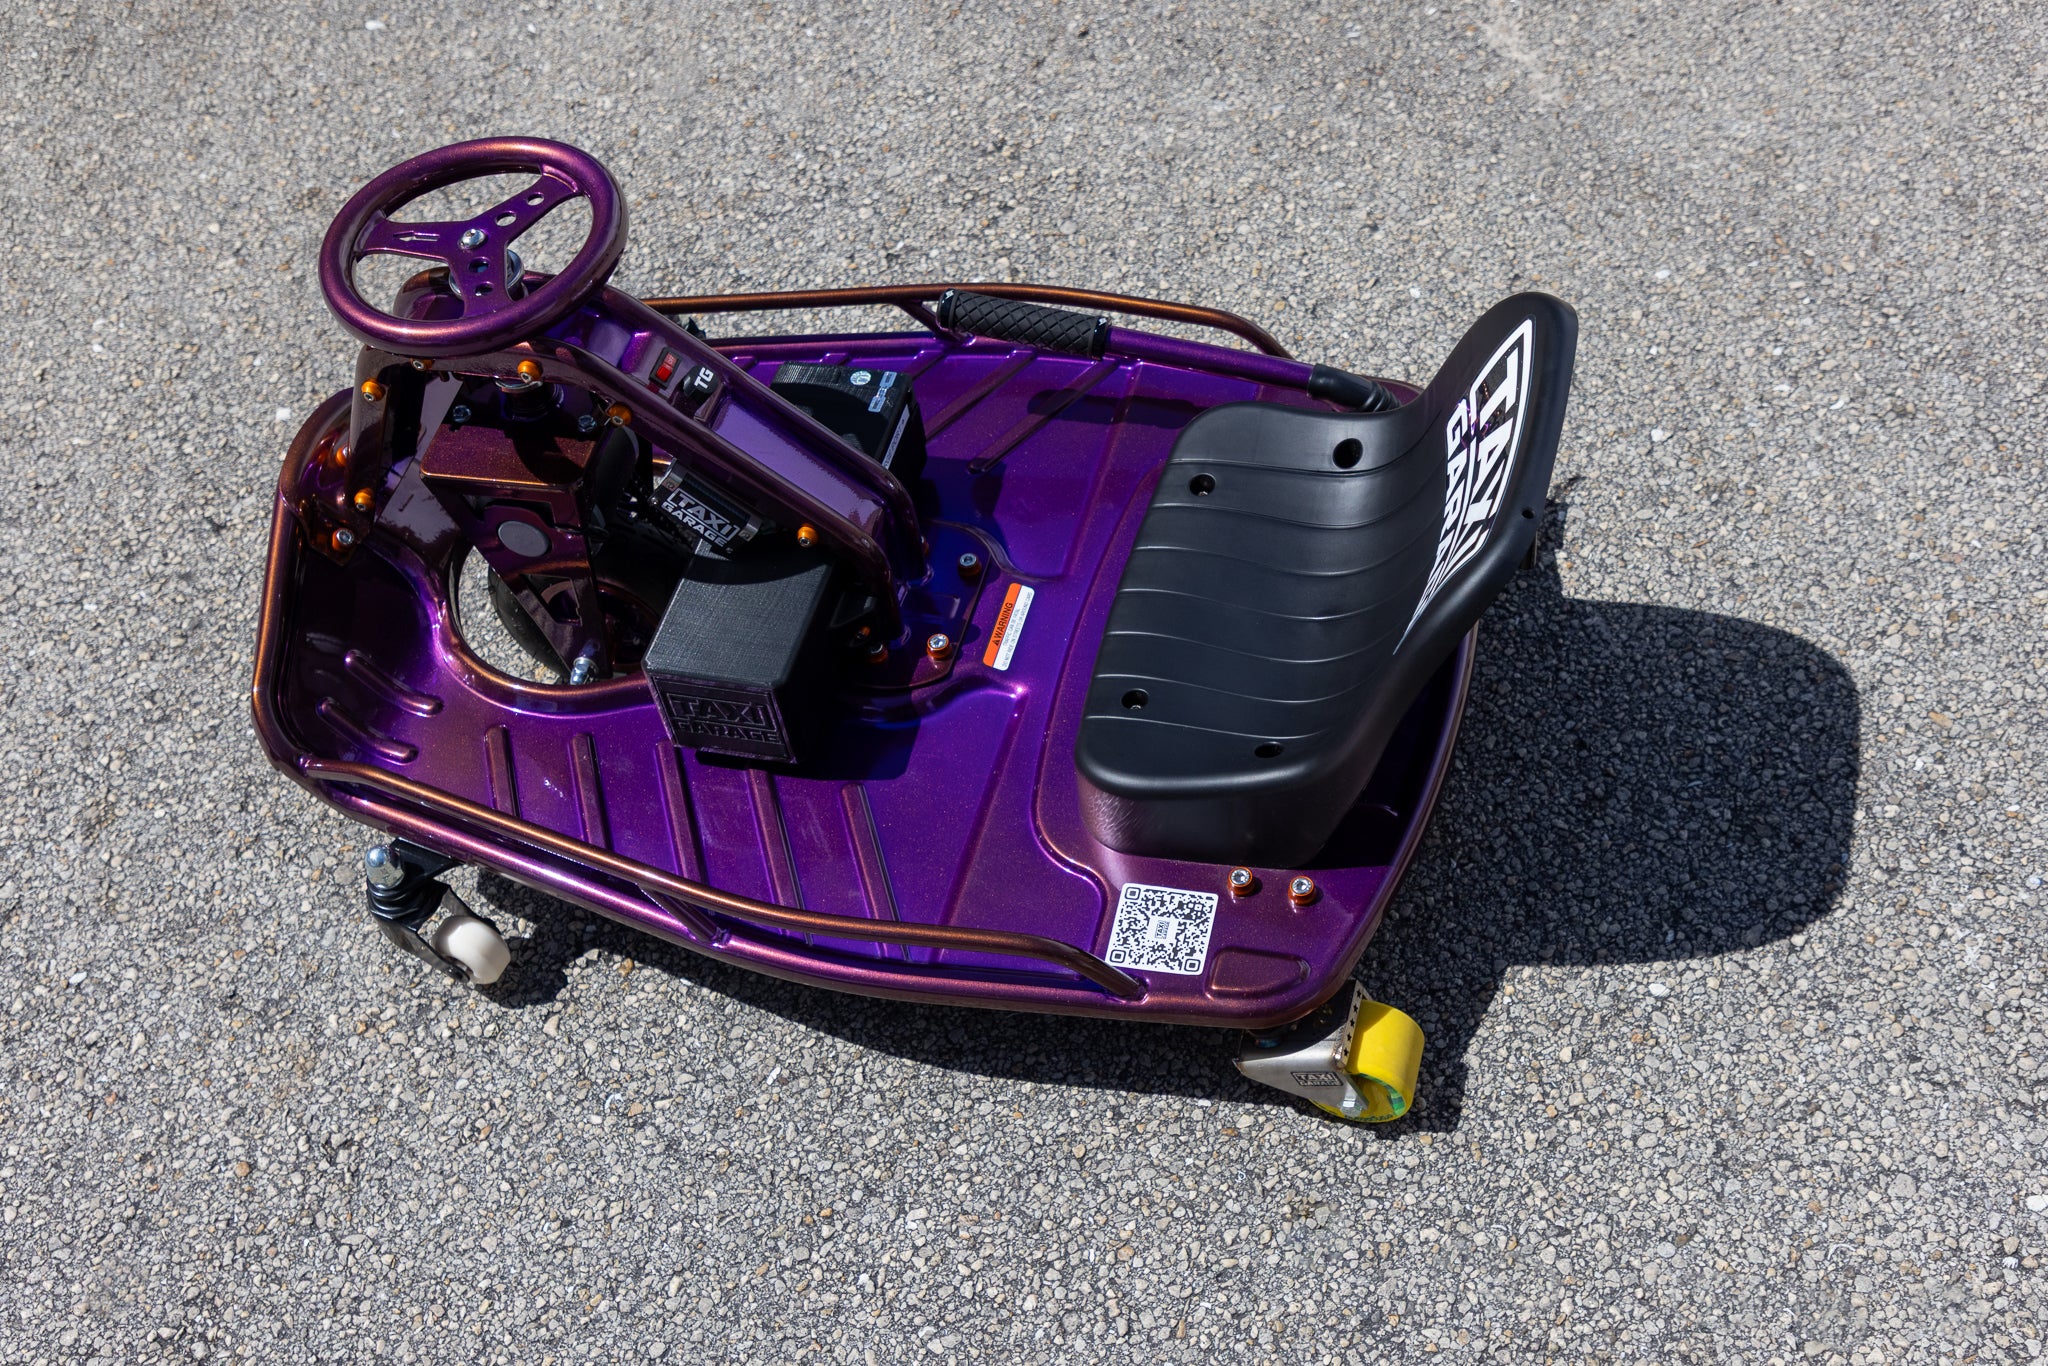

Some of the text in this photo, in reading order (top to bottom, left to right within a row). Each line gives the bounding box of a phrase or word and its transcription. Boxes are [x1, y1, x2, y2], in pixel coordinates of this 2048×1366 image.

[694, 367, 714, 389] TG
[1444, 347, 1519, 576] TAXI
[661, 501, 728, 547] GARAGE
[678, 492, 734, 536] TAXI
[993, 602, 1013, 639] WARNING
[672, 700, 766, 725] TAXI
